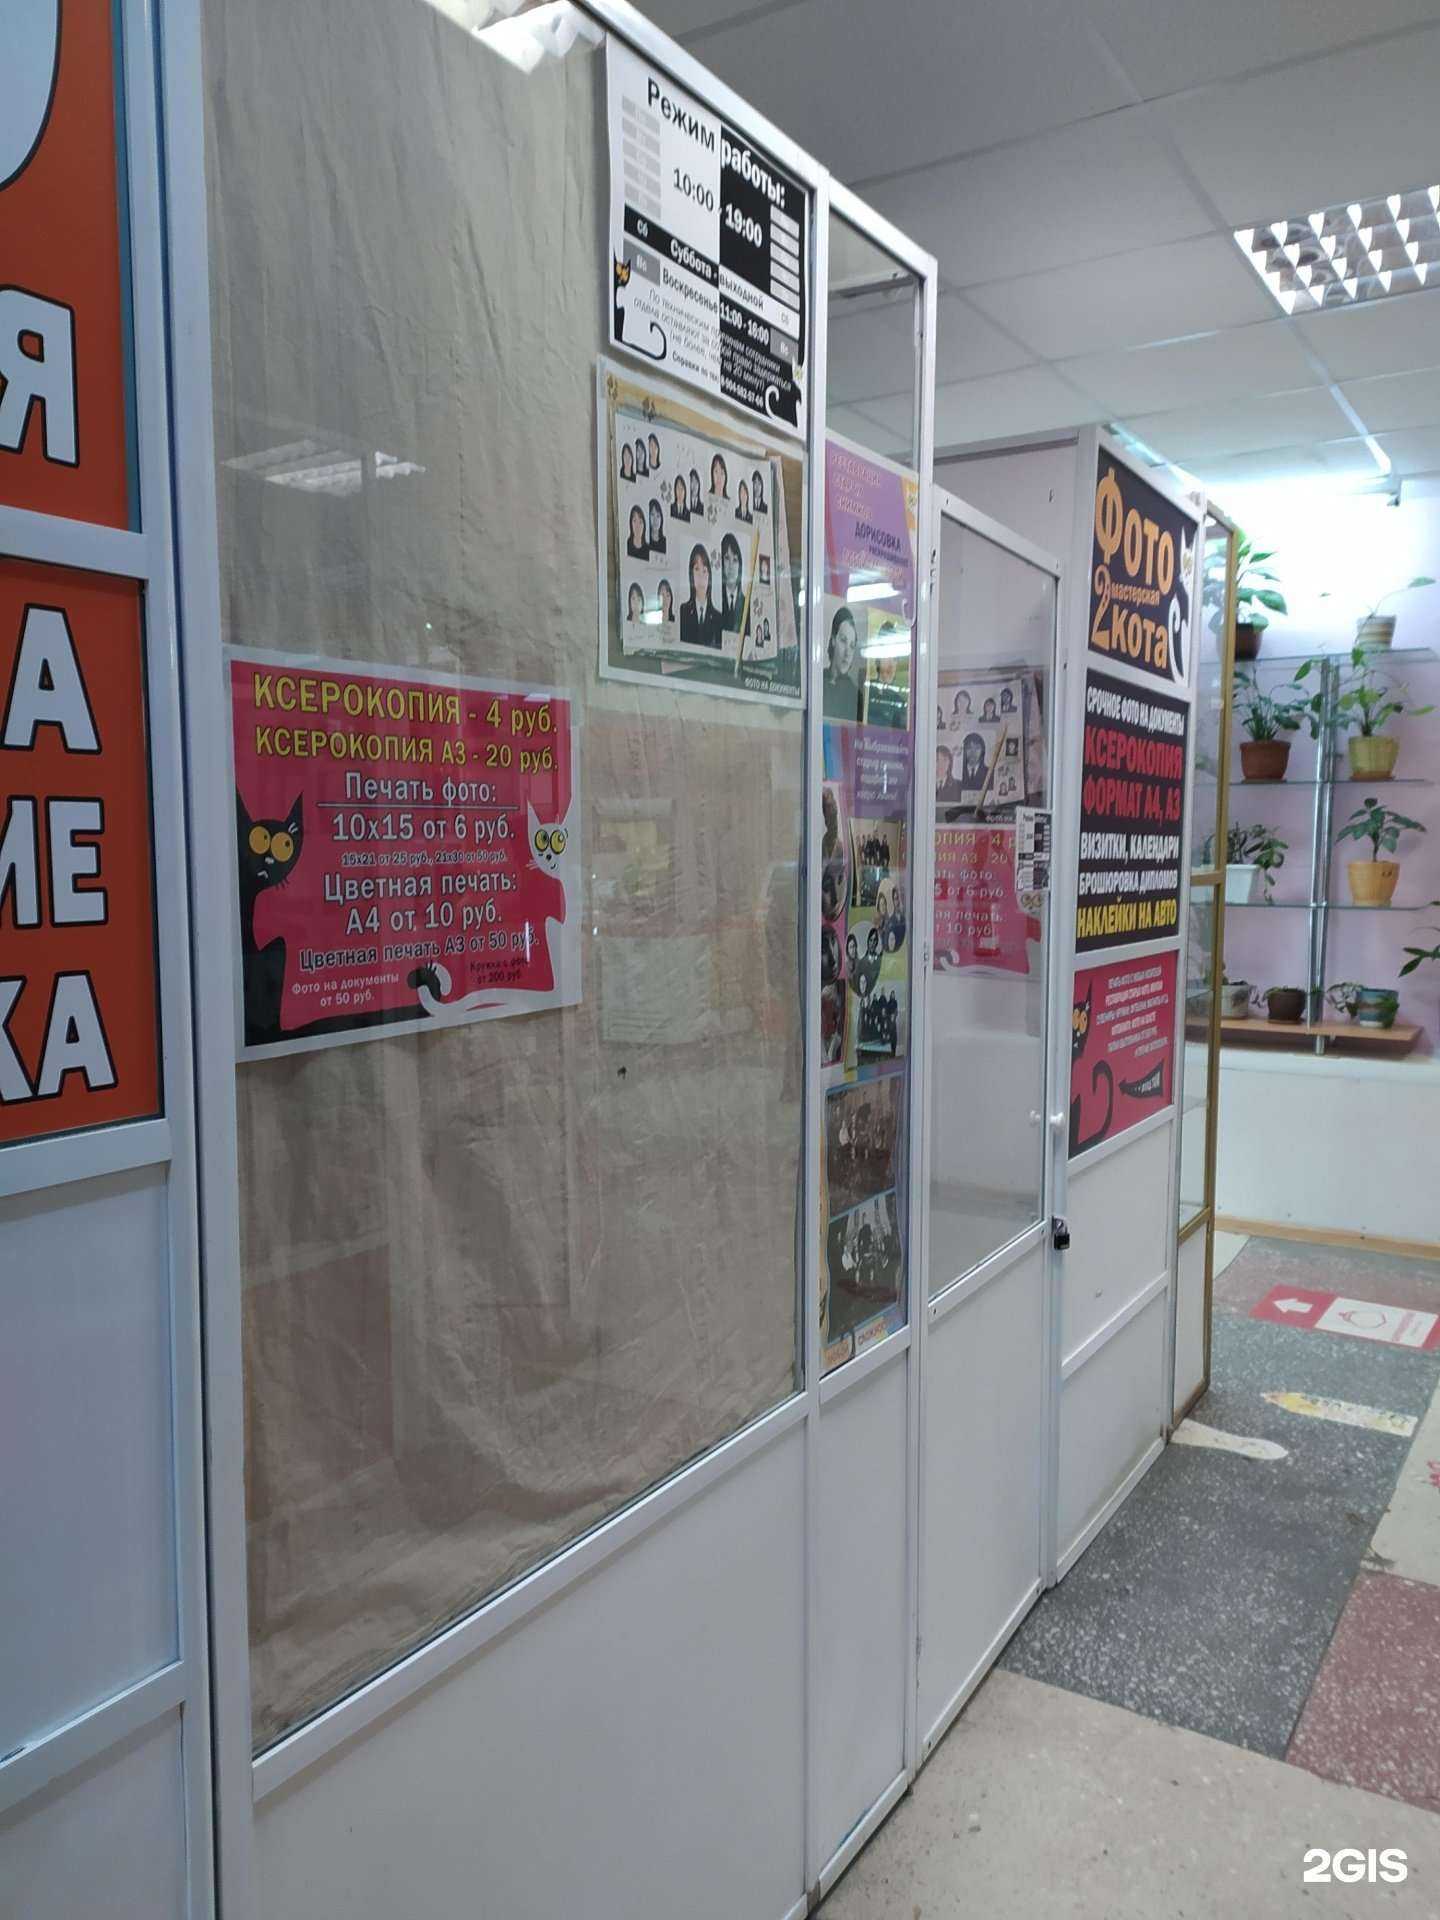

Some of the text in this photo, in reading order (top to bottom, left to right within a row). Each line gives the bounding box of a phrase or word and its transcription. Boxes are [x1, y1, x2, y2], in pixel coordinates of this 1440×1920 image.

[647, 76, 785, 209] Режим работы:
[673, 168, 714, 212] 10:00
[725, 203, 763, 248] 19:00
[670, 238, 712, 280] Суббота
[719, 274, 764, 311] выходной
[662, 267, 718, 315] Воскресенье
[719, 301, 743, 330] 11:00
[1111, 582, 1160, 607] мастерская
[253, 672, 559, 737] КСЕРОКОПИЯ - 4 руб.
[1086, 686, 1121, 720] СРОЧНОЕ
[1121, 695, 1140, 726] ФОТО
[1139, 702, 1149, 729] НА
[255, 725, 559, 774] КСЕРОКОПИЯ А3 - 20 руб.
[1085, 724, 1184, 780] КСЕРОКОПИЯ
[345, 771, 498, 808] Печать фото:
[1083, 773, 1143, 819] ФОРМАТ
[1166, 786, 1182, 821] А3
[423, 819, 447, 840] от
[454, 814, 468, 840] 6
[475, 814, 516, 845] руб.
[1080, 832, 1129, 865] ВИЗИТКИ,
[1130, 834, 1180, 865] КАЛЕНДАРИ
[378, 854, 391, 867] от
[1079, 868, 1178, 896] БРОШЮРОВКА ДИПЛОМОВ
[324, 871, 518, 905] Цветная печать:
[346, 905, 380, 935] А4
[426, 901, 453, 929] 10
[462, 897, 503, 931] руб.
[1076, 896, 1177, 939] НАКЛЕЙКИ НА АВТО
[299, 945, 379, 974] Цветная
[382, 938, 440, 963] печать
[445, 933, 466, 956] А3
[470, 934, 486, 953] от
[489, 930, 508, 950] 50
[291, 972, 400, 995] Фото на документы
[320, 995, 332, 1008] от
[353, 988, 375, 1006] руб.
